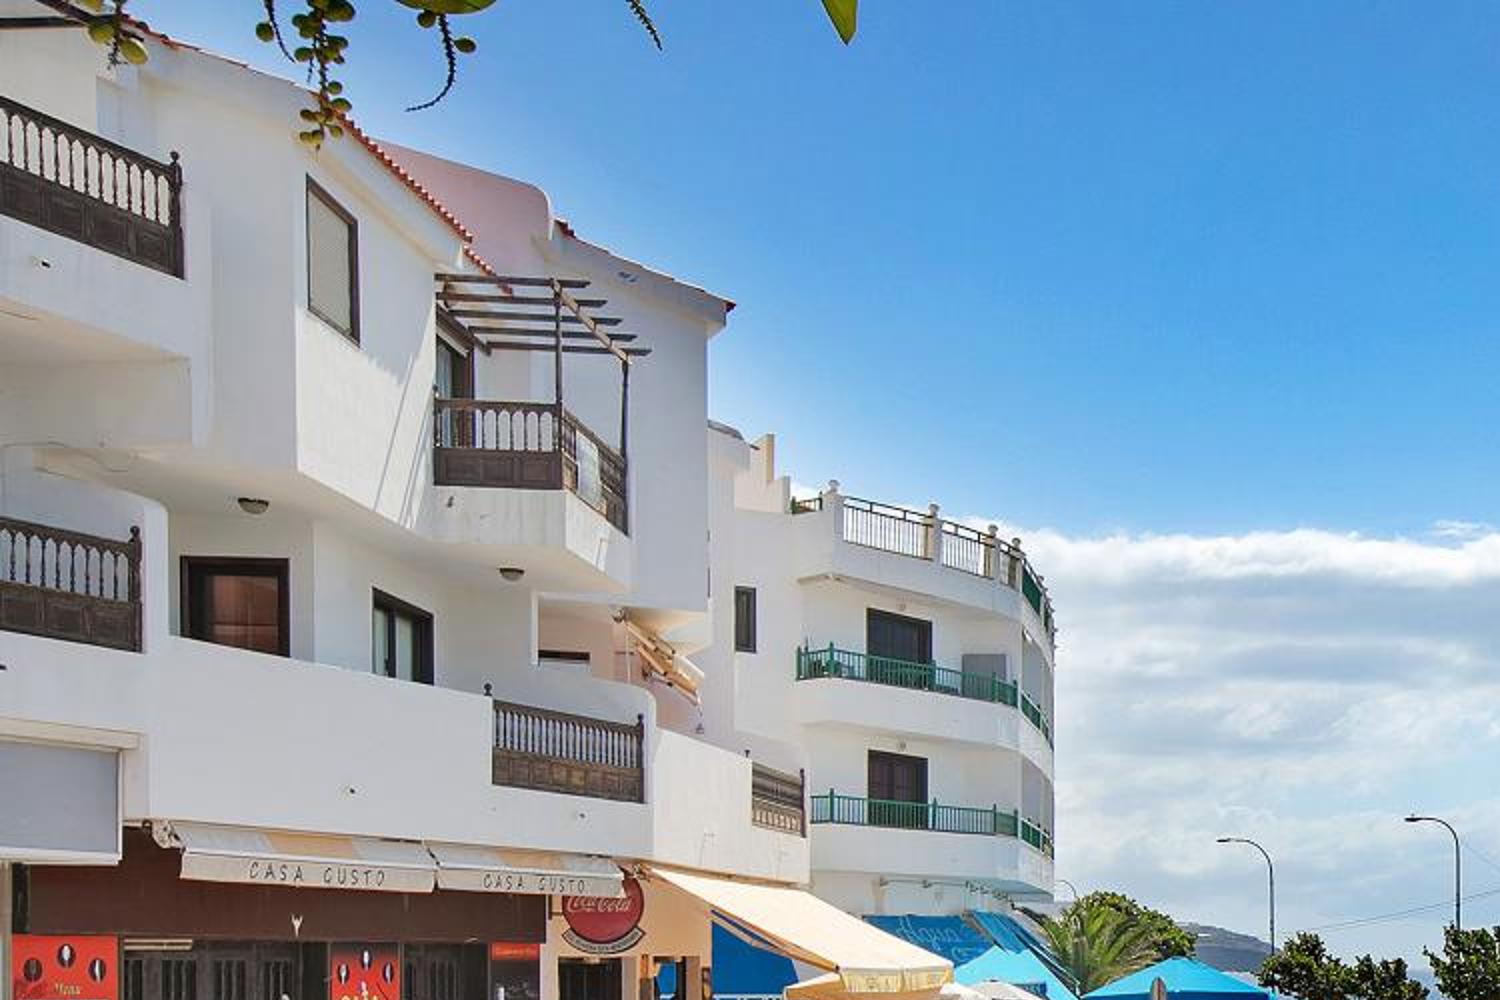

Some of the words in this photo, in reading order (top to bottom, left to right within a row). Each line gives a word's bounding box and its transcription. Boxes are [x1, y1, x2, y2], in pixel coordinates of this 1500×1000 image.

[249, 861, 304, 882] CASA
[324, 867, 386, 887] GUSTO
[483, 874, 524, 890] CASA
[539, 877, 586, 893] GUSTO
